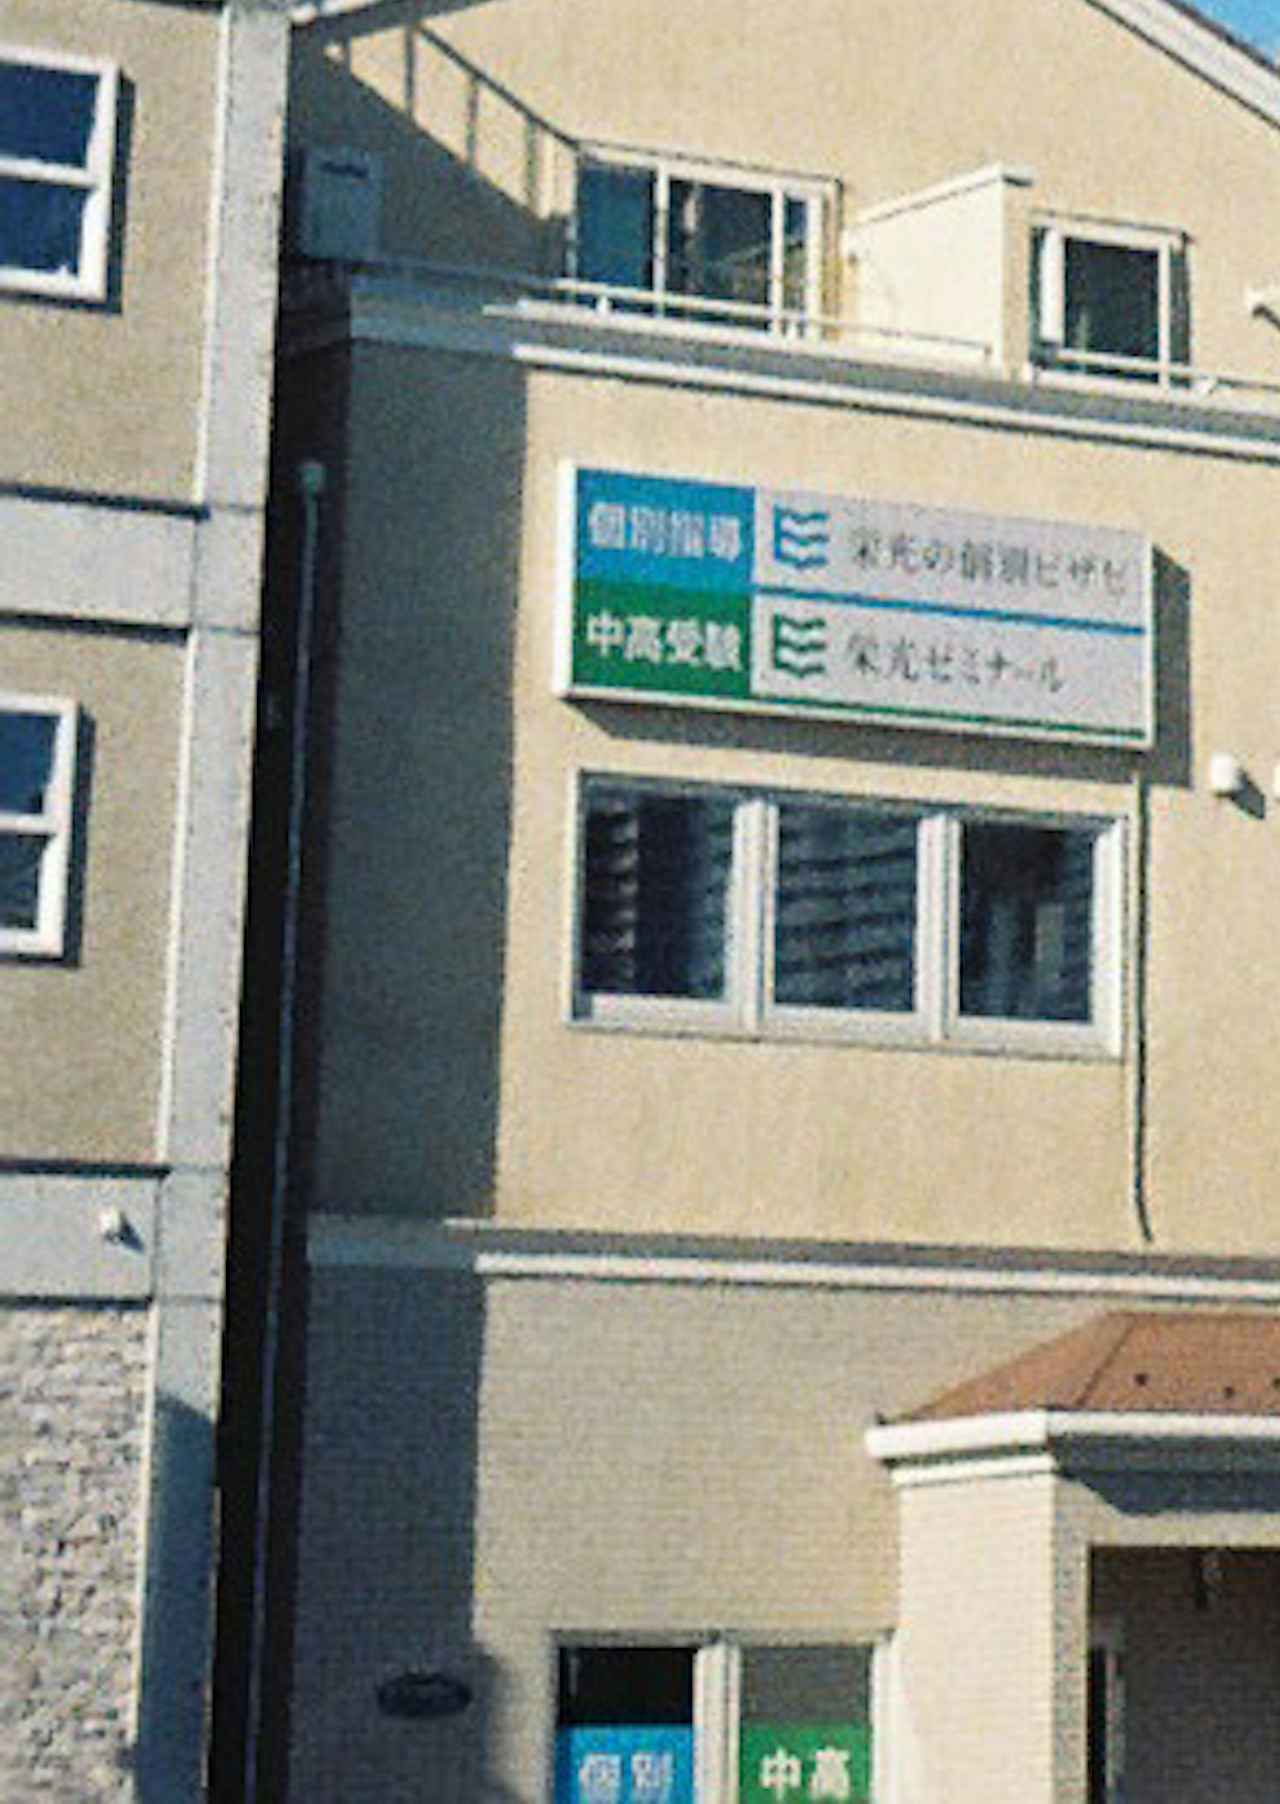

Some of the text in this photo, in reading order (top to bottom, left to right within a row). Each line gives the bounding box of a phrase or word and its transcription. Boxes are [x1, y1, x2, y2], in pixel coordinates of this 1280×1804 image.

[588, 501, 742, 562] 個別指導
[586, 608, 742, 672] 中高受験
[848, 634, 1064, 693] 栄光ゼミナール
